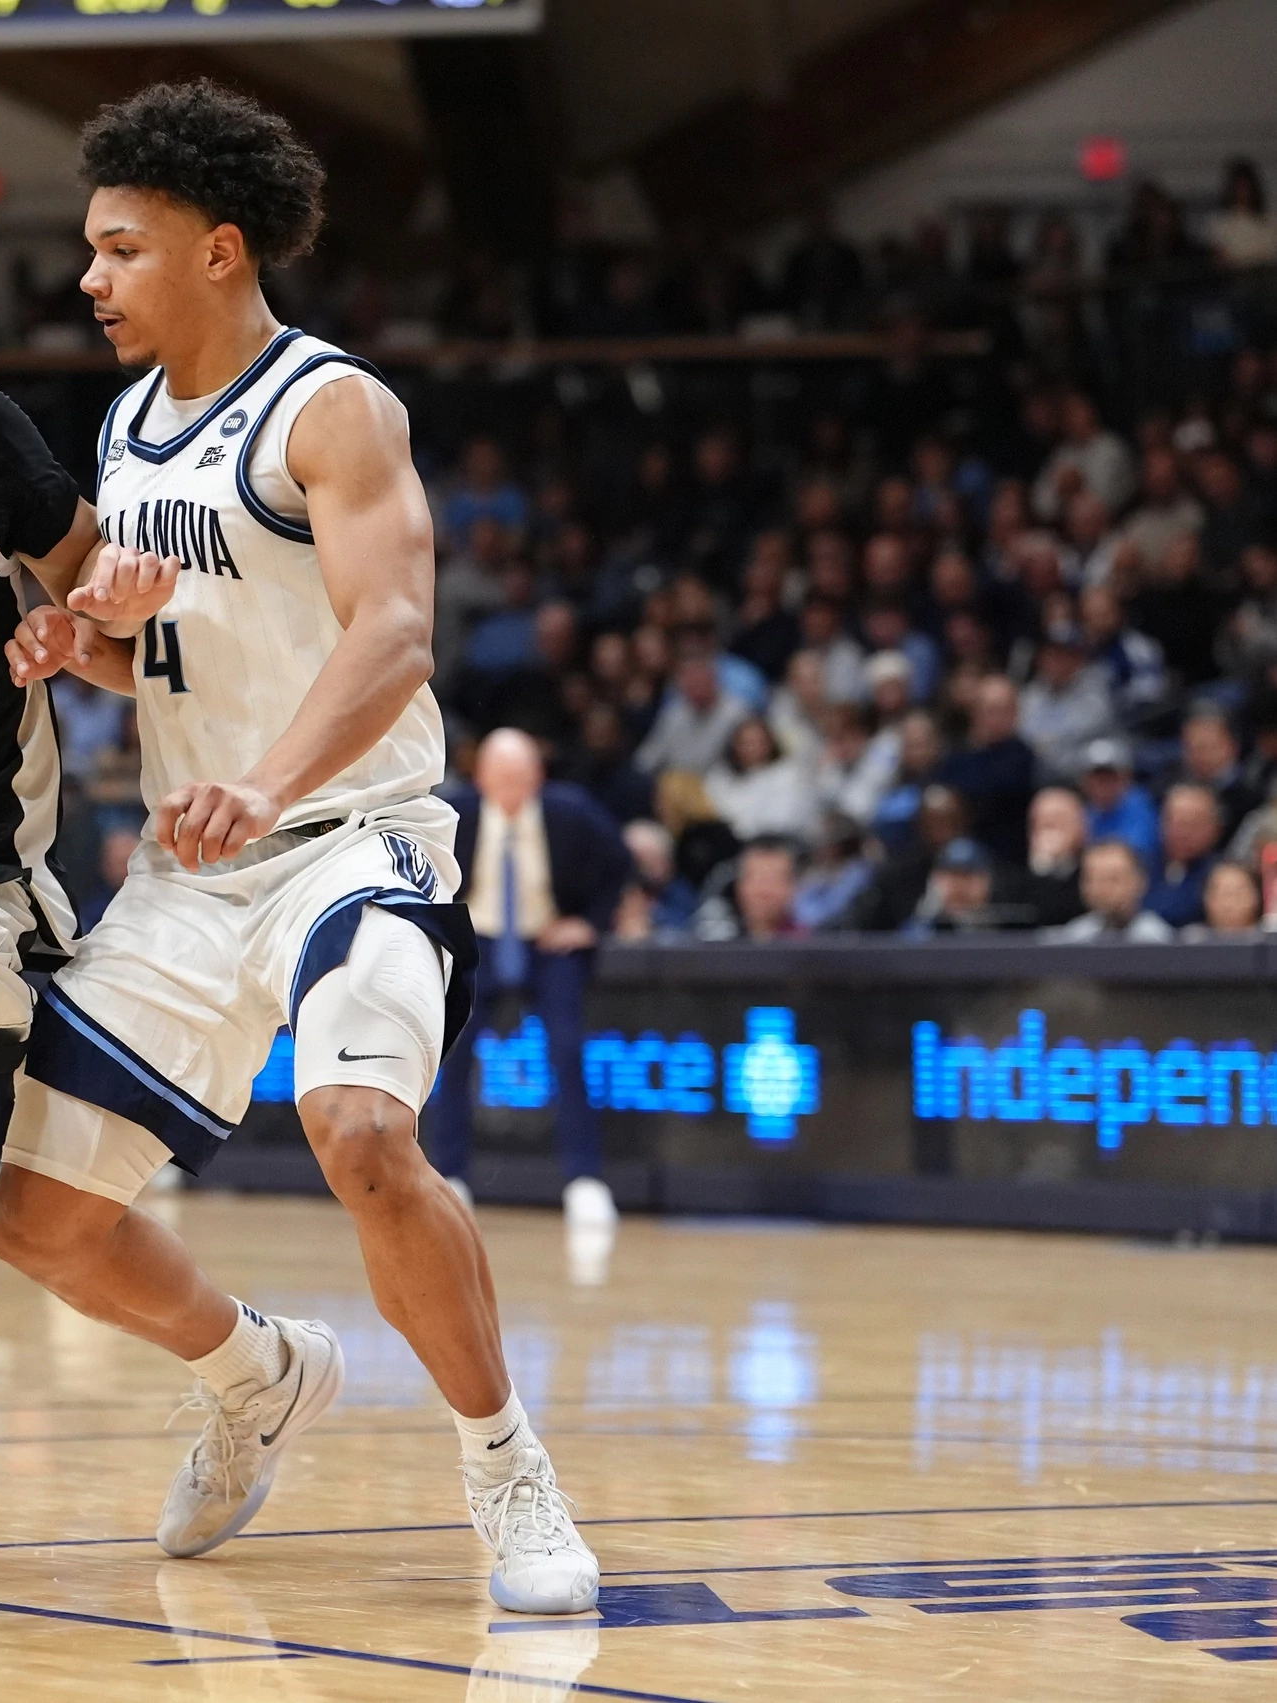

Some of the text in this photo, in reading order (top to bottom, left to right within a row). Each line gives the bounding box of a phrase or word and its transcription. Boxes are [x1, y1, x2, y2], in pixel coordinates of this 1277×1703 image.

[198, 454, 227, 465] EAST
[204, 445, 224, 456] BIG
[143, 613, 192, 695] 4
[911, 1009, 1277, 1149] Indepen
